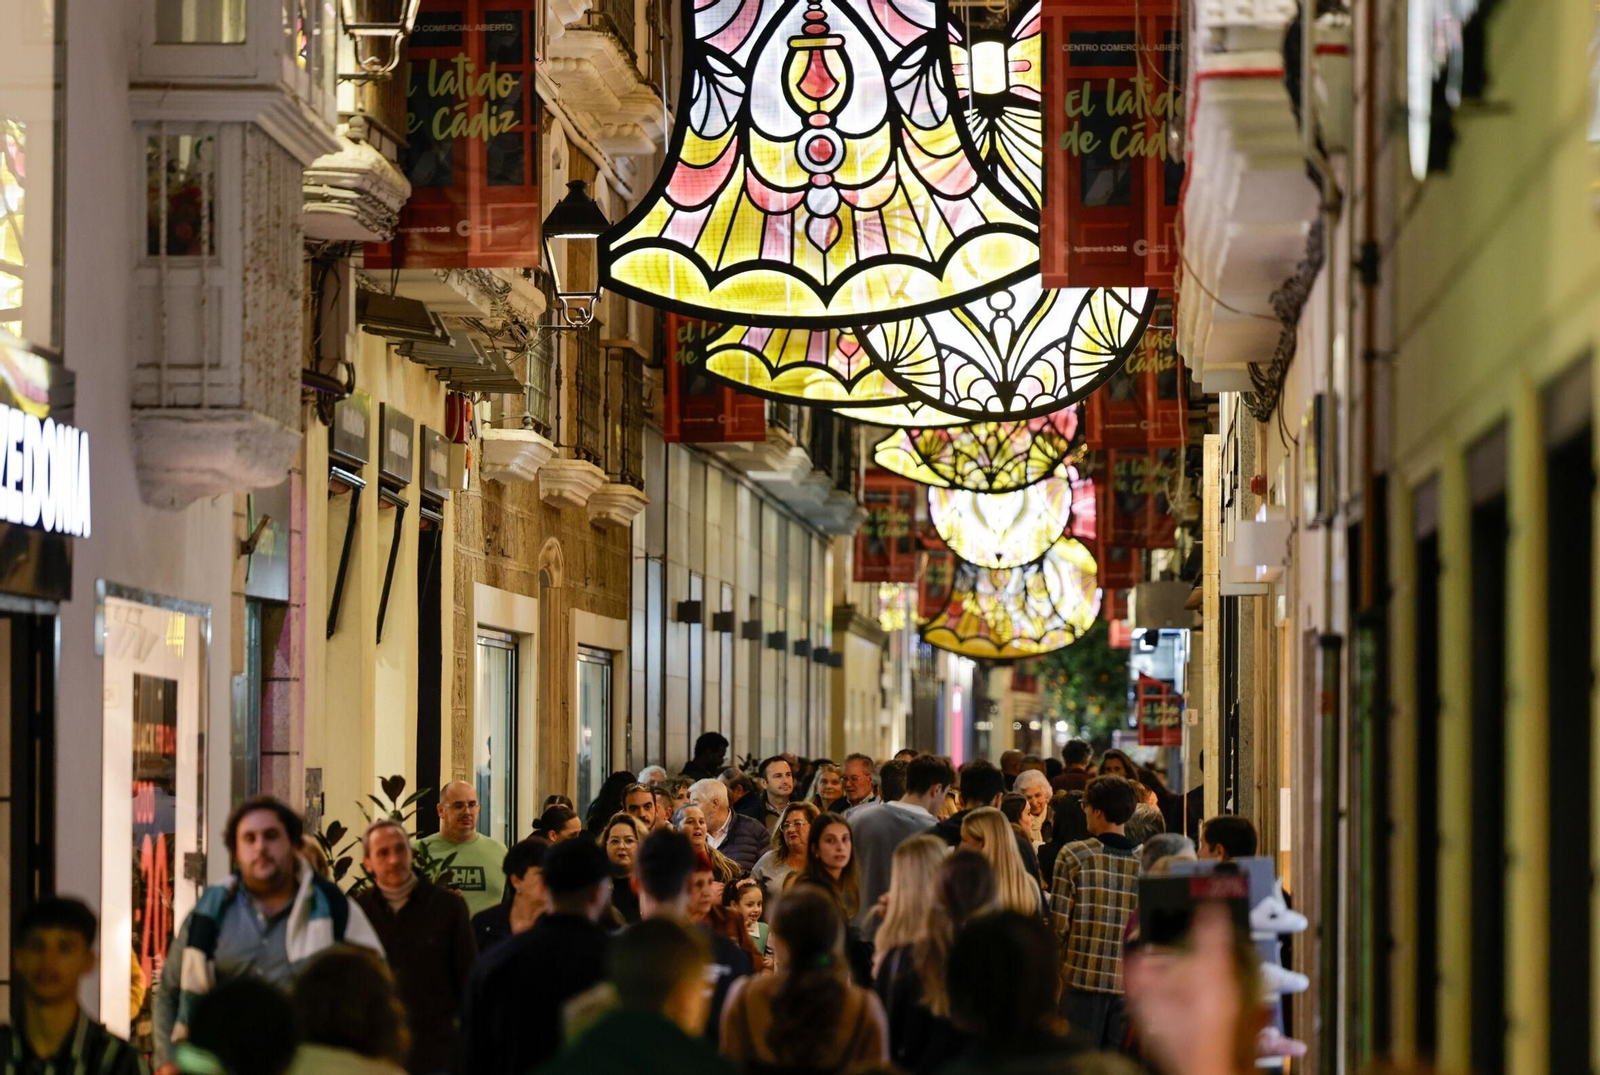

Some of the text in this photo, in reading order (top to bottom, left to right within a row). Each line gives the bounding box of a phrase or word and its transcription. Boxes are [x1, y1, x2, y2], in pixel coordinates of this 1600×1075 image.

[422, 24, 473, 32] COMERCIAL
[474, 23, 513, 32] ABIERTO
[1062, 43, 1099, 52] CENTRO
[427, 52, 519, 101] latido
[1064, 80, 1096, 118] El
[431, 101, 521, 142] Cádiz
[1059, 121, 1167, 162] de Cád
[674, 345, 699, 367] de
[1125, 348, 1177, 374] Cádiz
